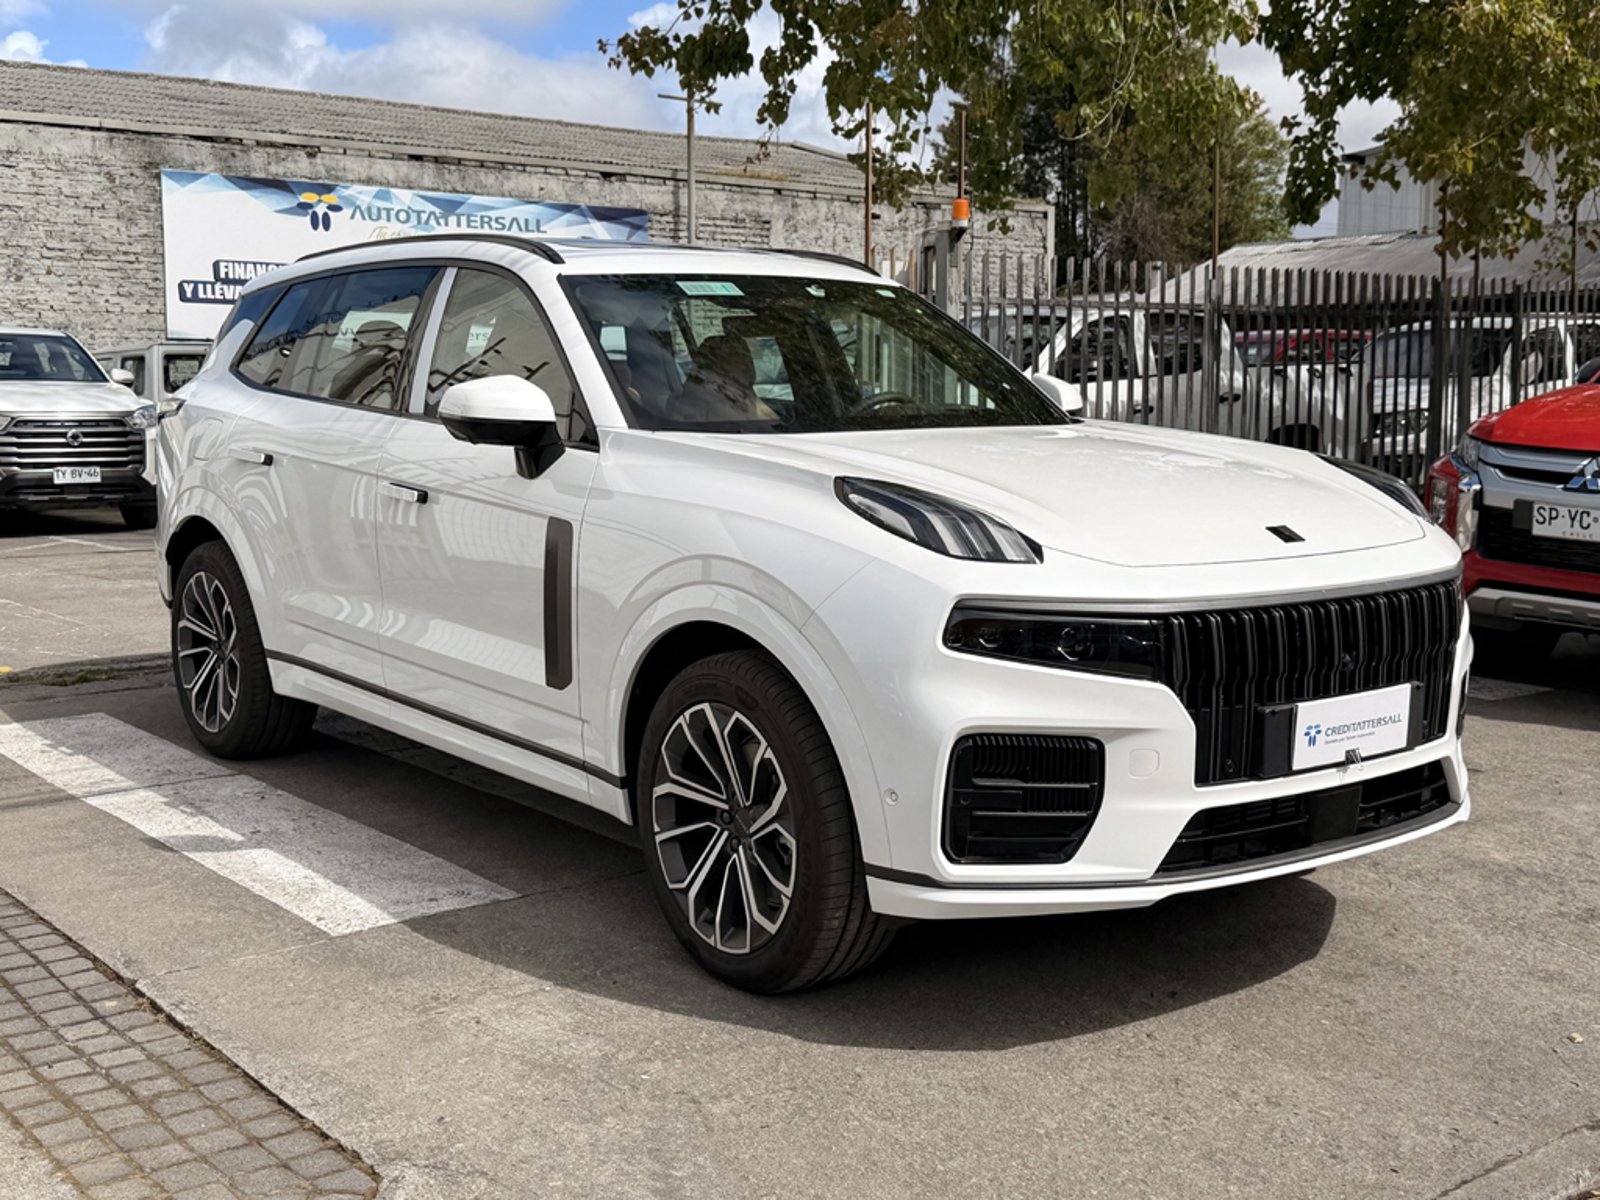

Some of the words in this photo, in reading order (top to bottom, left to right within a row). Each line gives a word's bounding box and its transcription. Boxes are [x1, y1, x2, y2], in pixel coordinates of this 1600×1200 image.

[350, 204, 548, 234] AUTOTATTERSALL
[219, 262, 280, 280] FINAN
[182, 282, 194, 299] Y
